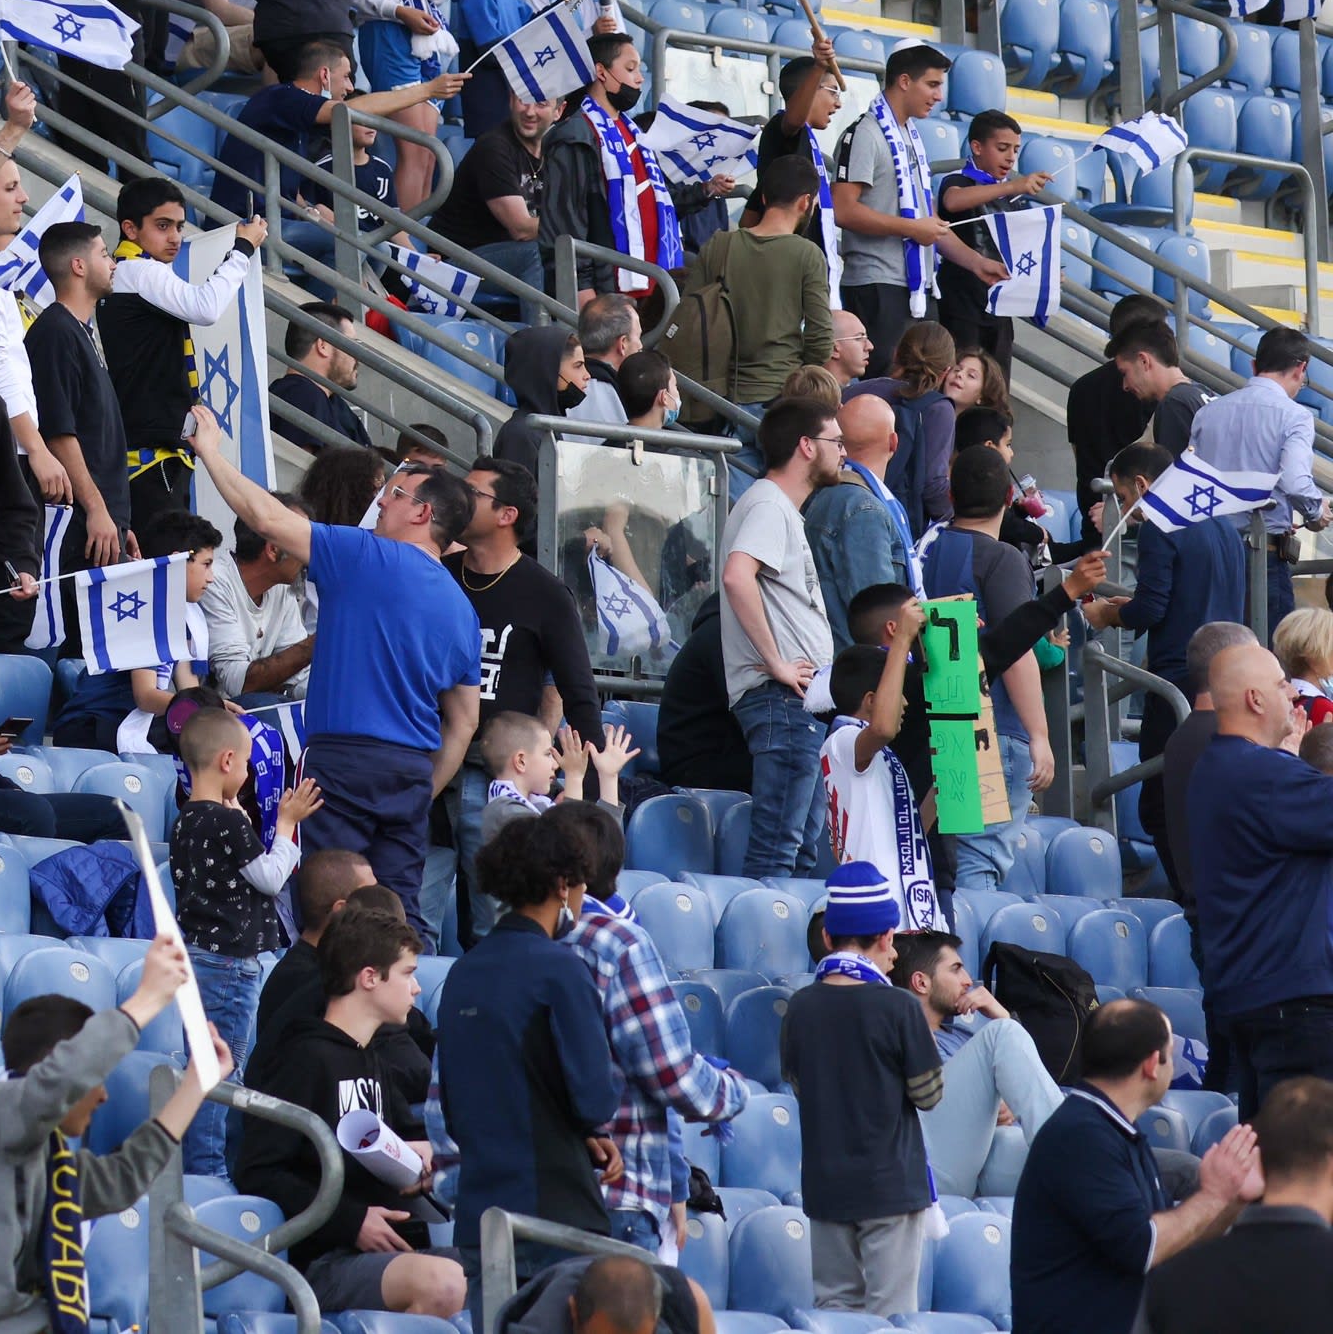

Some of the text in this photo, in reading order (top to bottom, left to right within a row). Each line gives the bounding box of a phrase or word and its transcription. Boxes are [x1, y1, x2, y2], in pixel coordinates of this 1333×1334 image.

[898, 804, 910, 824] טדי
[898, 826, 915, 875] אצטדיון
[50, 1127, 88, 1326] ACCABI
